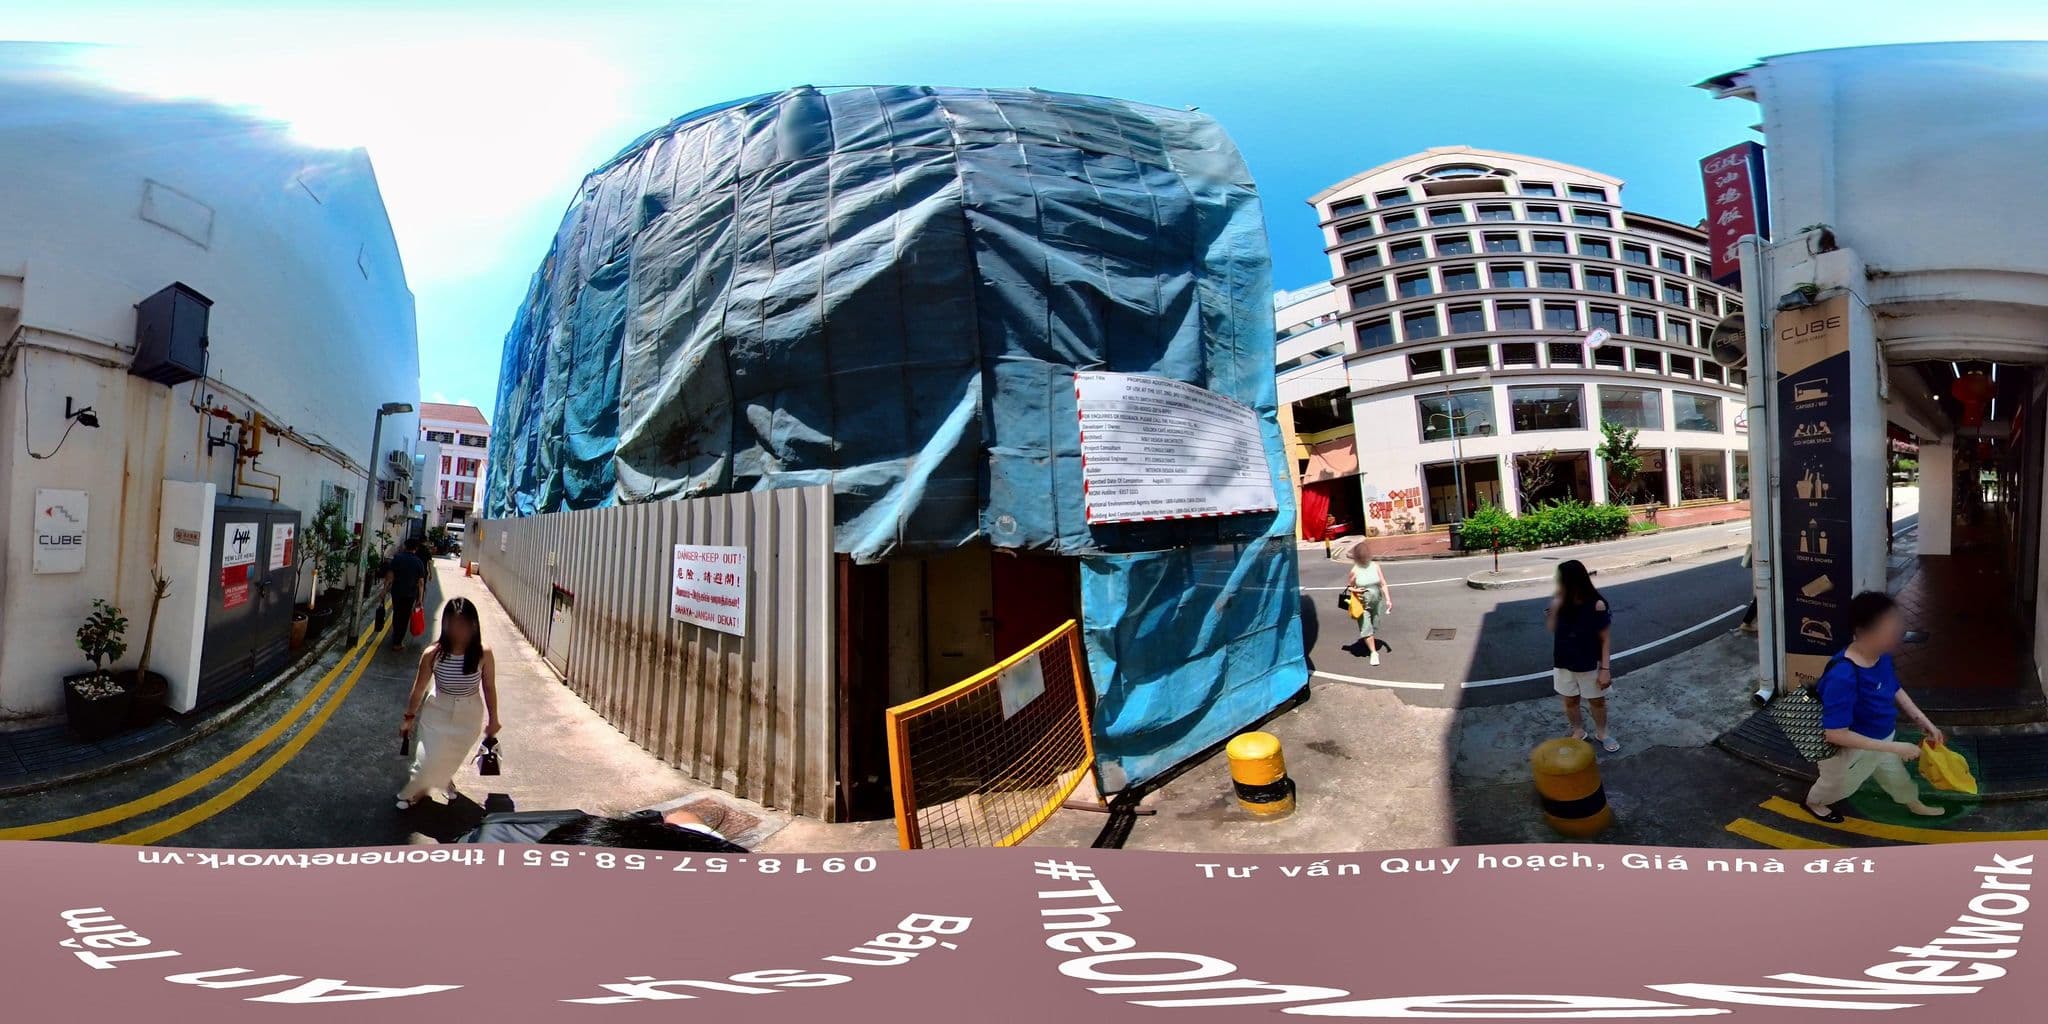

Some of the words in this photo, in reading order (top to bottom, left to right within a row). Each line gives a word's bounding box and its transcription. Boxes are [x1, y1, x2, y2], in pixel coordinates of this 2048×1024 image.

[1781, 315, 1841, 341] CUBE
[39, 534, 82, 545] CUBE
[678, 550, 720, 563] DANGER-KEEP
[722, 553, 742, 565] OUT!
[718, 614, 740, 629] DEKAT!
